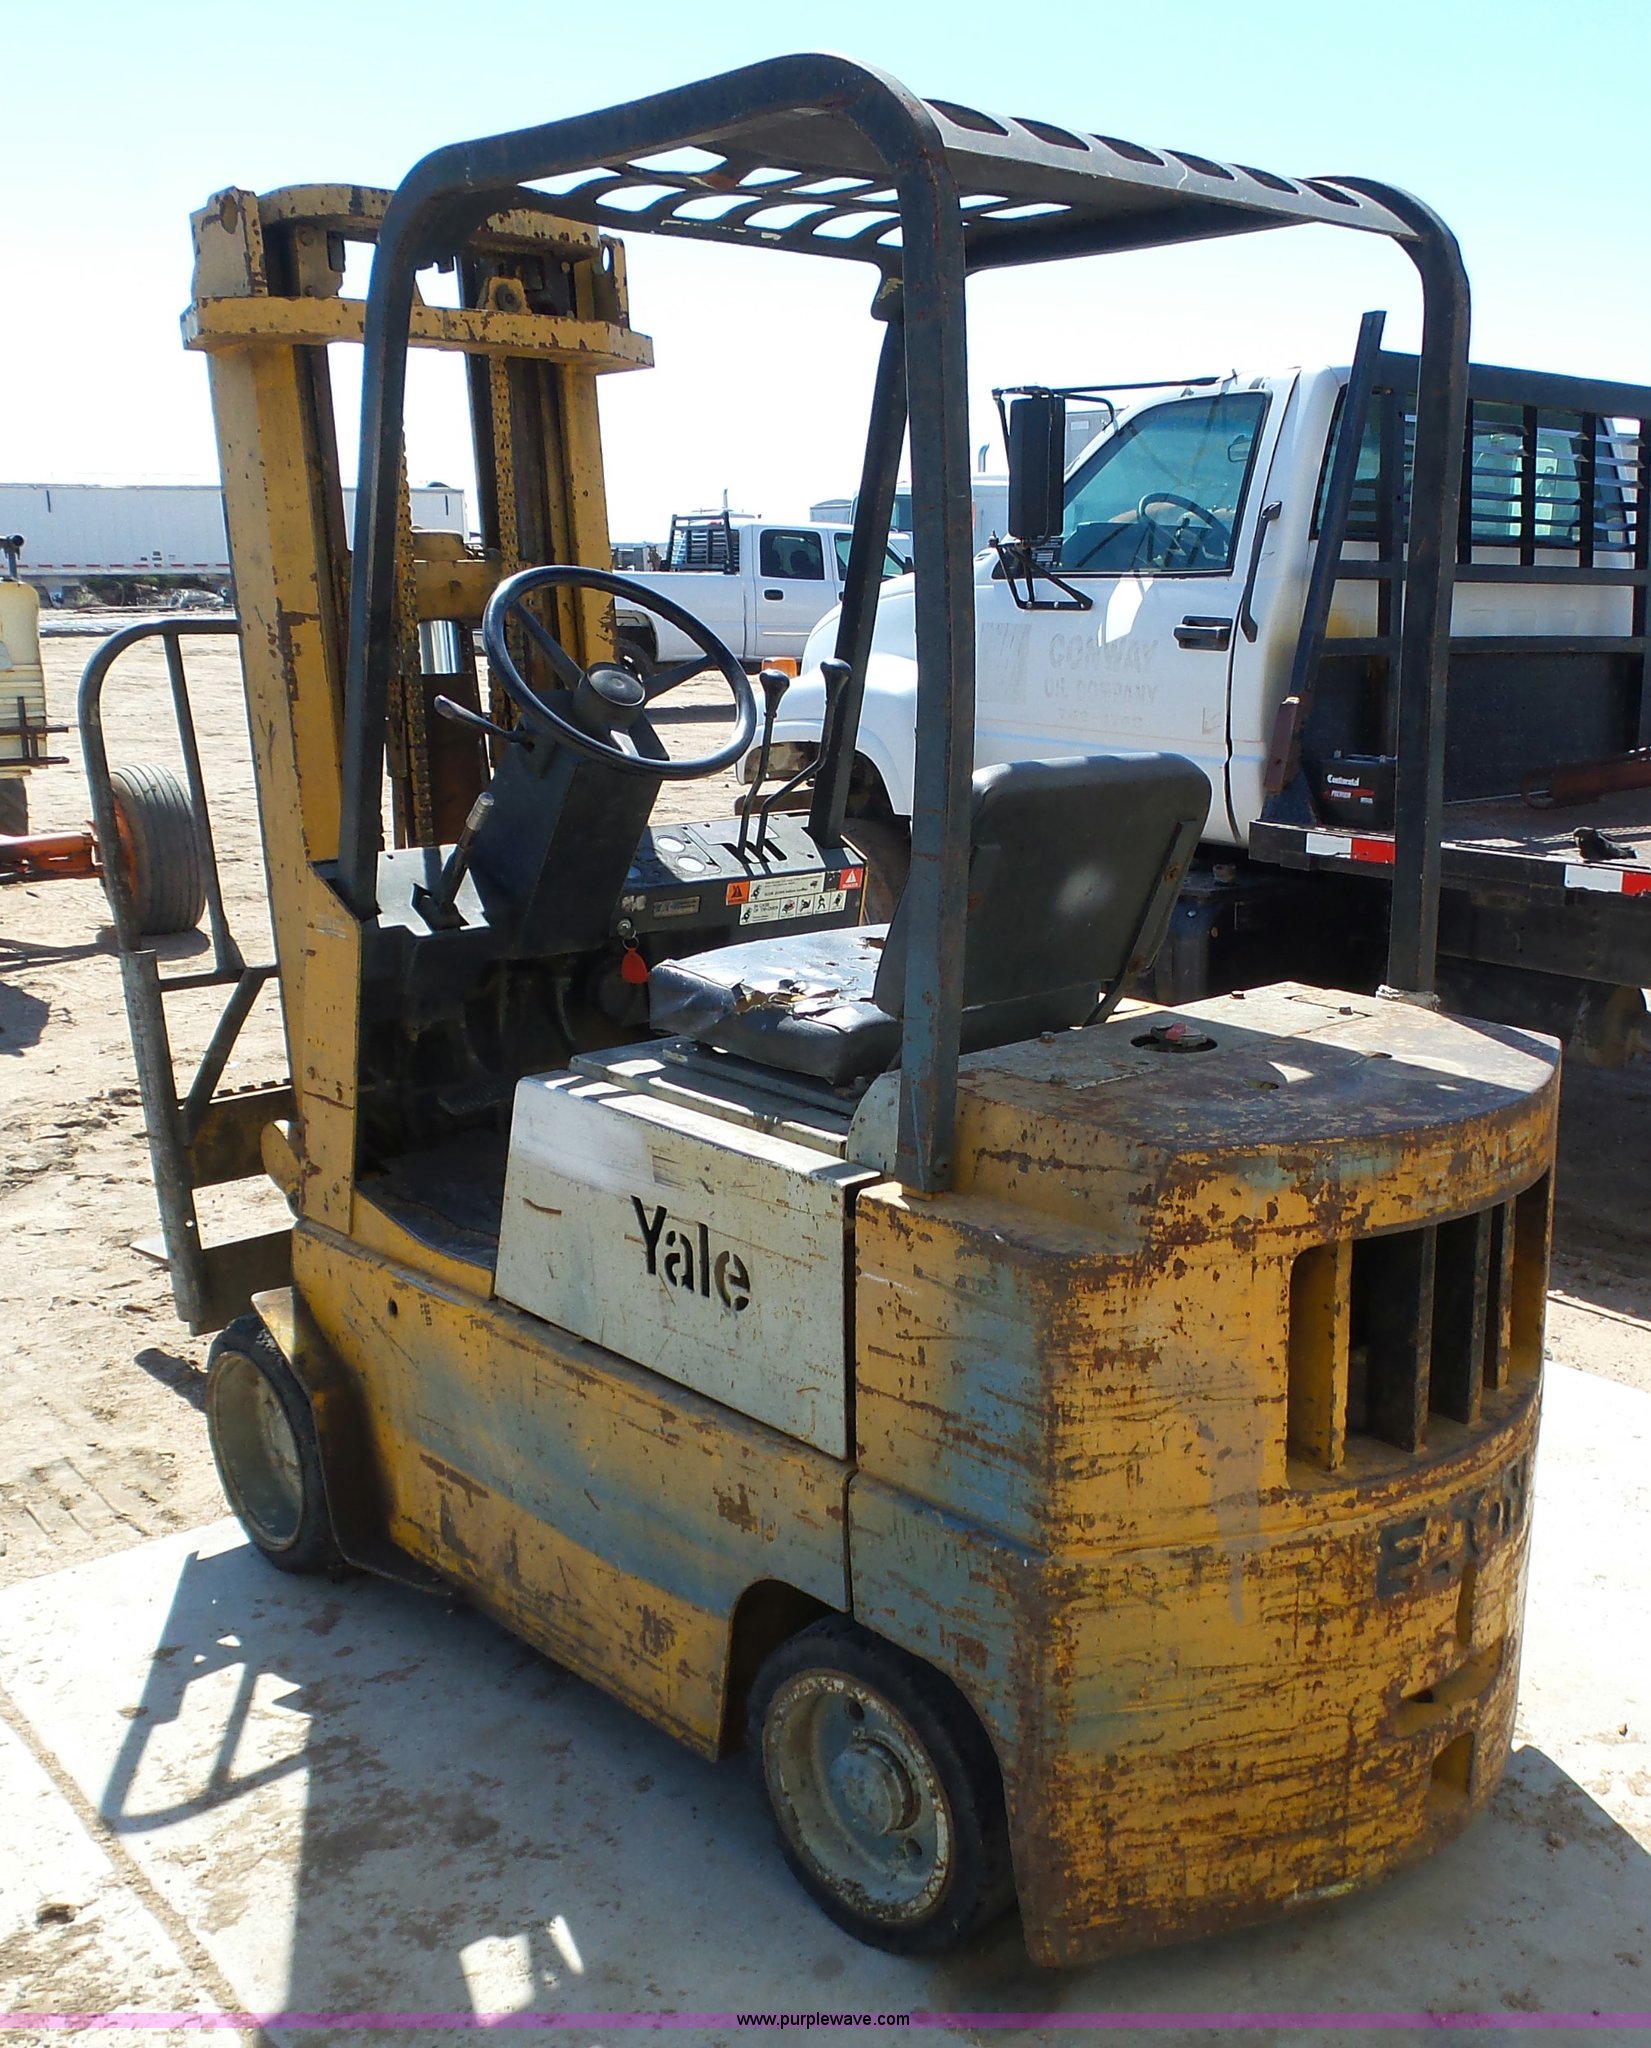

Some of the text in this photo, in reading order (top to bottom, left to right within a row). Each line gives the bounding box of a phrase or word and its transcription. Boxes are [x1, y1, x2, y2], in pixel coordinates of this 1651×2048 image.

[1048, 632, 1159, 674] CONWAY
[1044, 677, 1159, 704] OIL COMPANY
[630, 1194, 751, 1312] Yale
